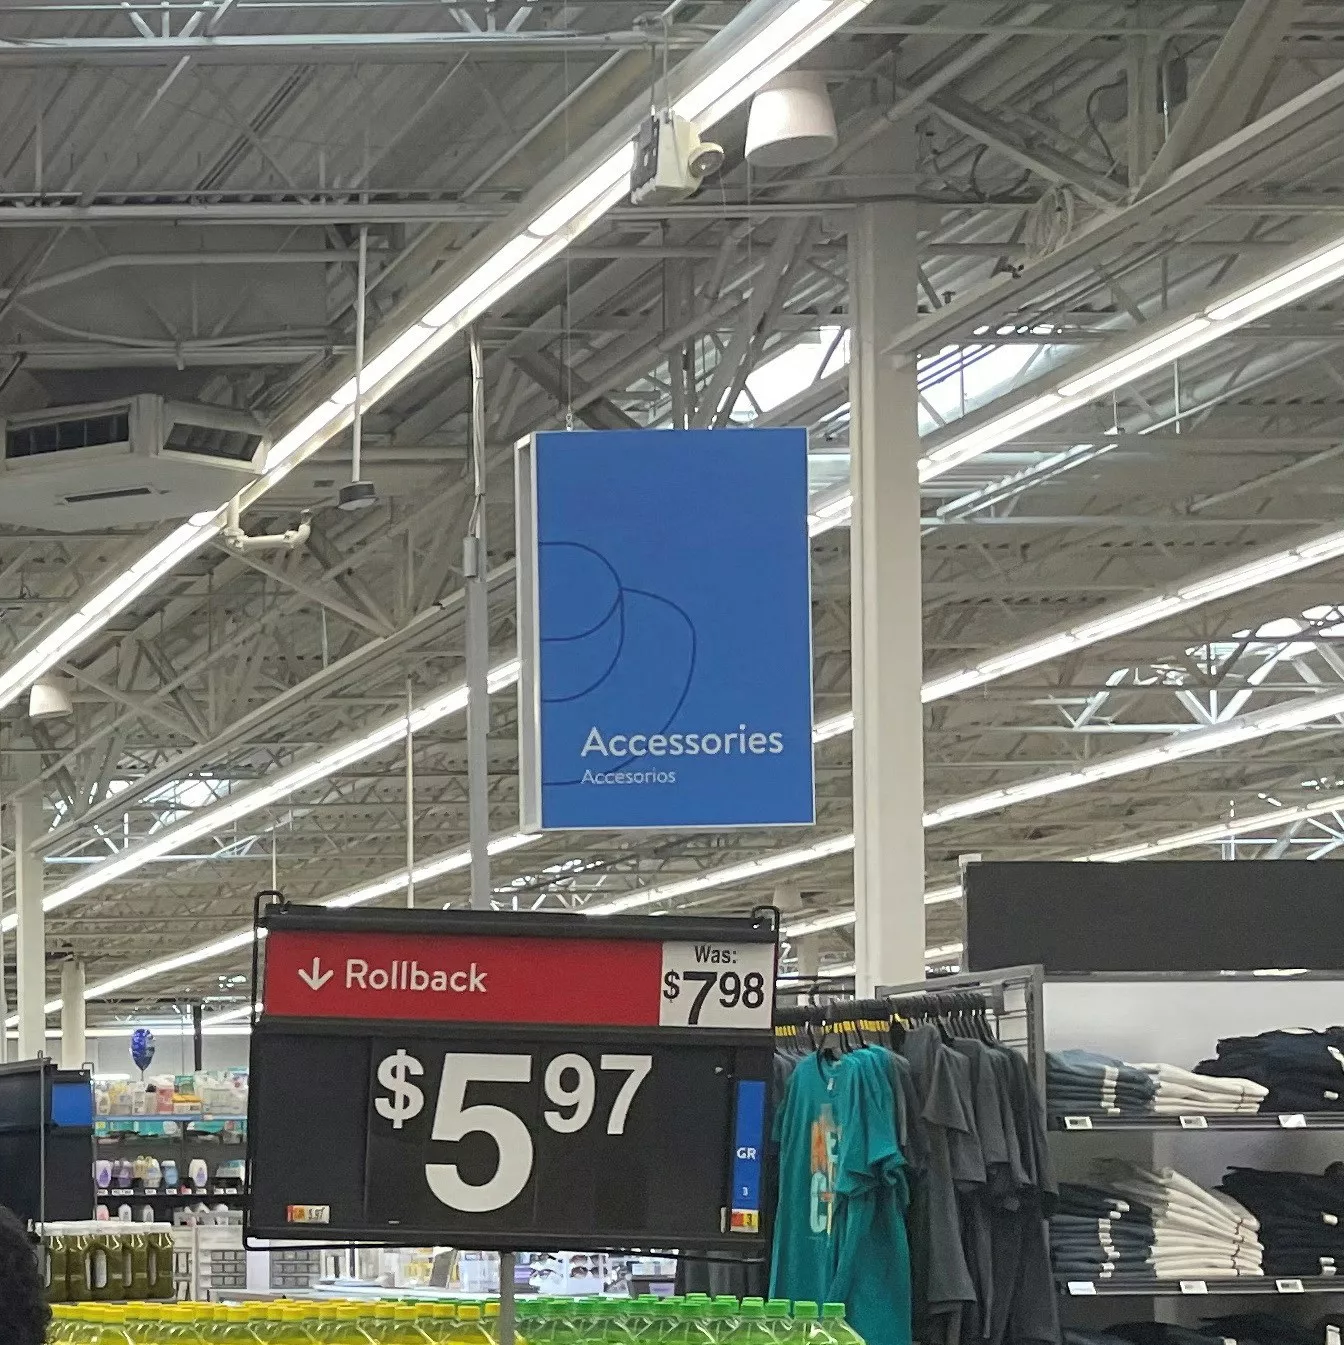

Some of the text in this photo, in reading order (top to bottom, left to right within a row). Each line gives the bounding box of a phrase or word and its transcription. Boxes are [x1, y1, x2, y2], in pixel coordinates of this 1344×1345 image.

[580, 724, 783, 758] Accessories
[580, 767, 676, 786] Accesorios
[694, 946, 737, 965] Was:
[345, 959, 488, 994] Rollback
[736, 1147, 757, 1160] GR
